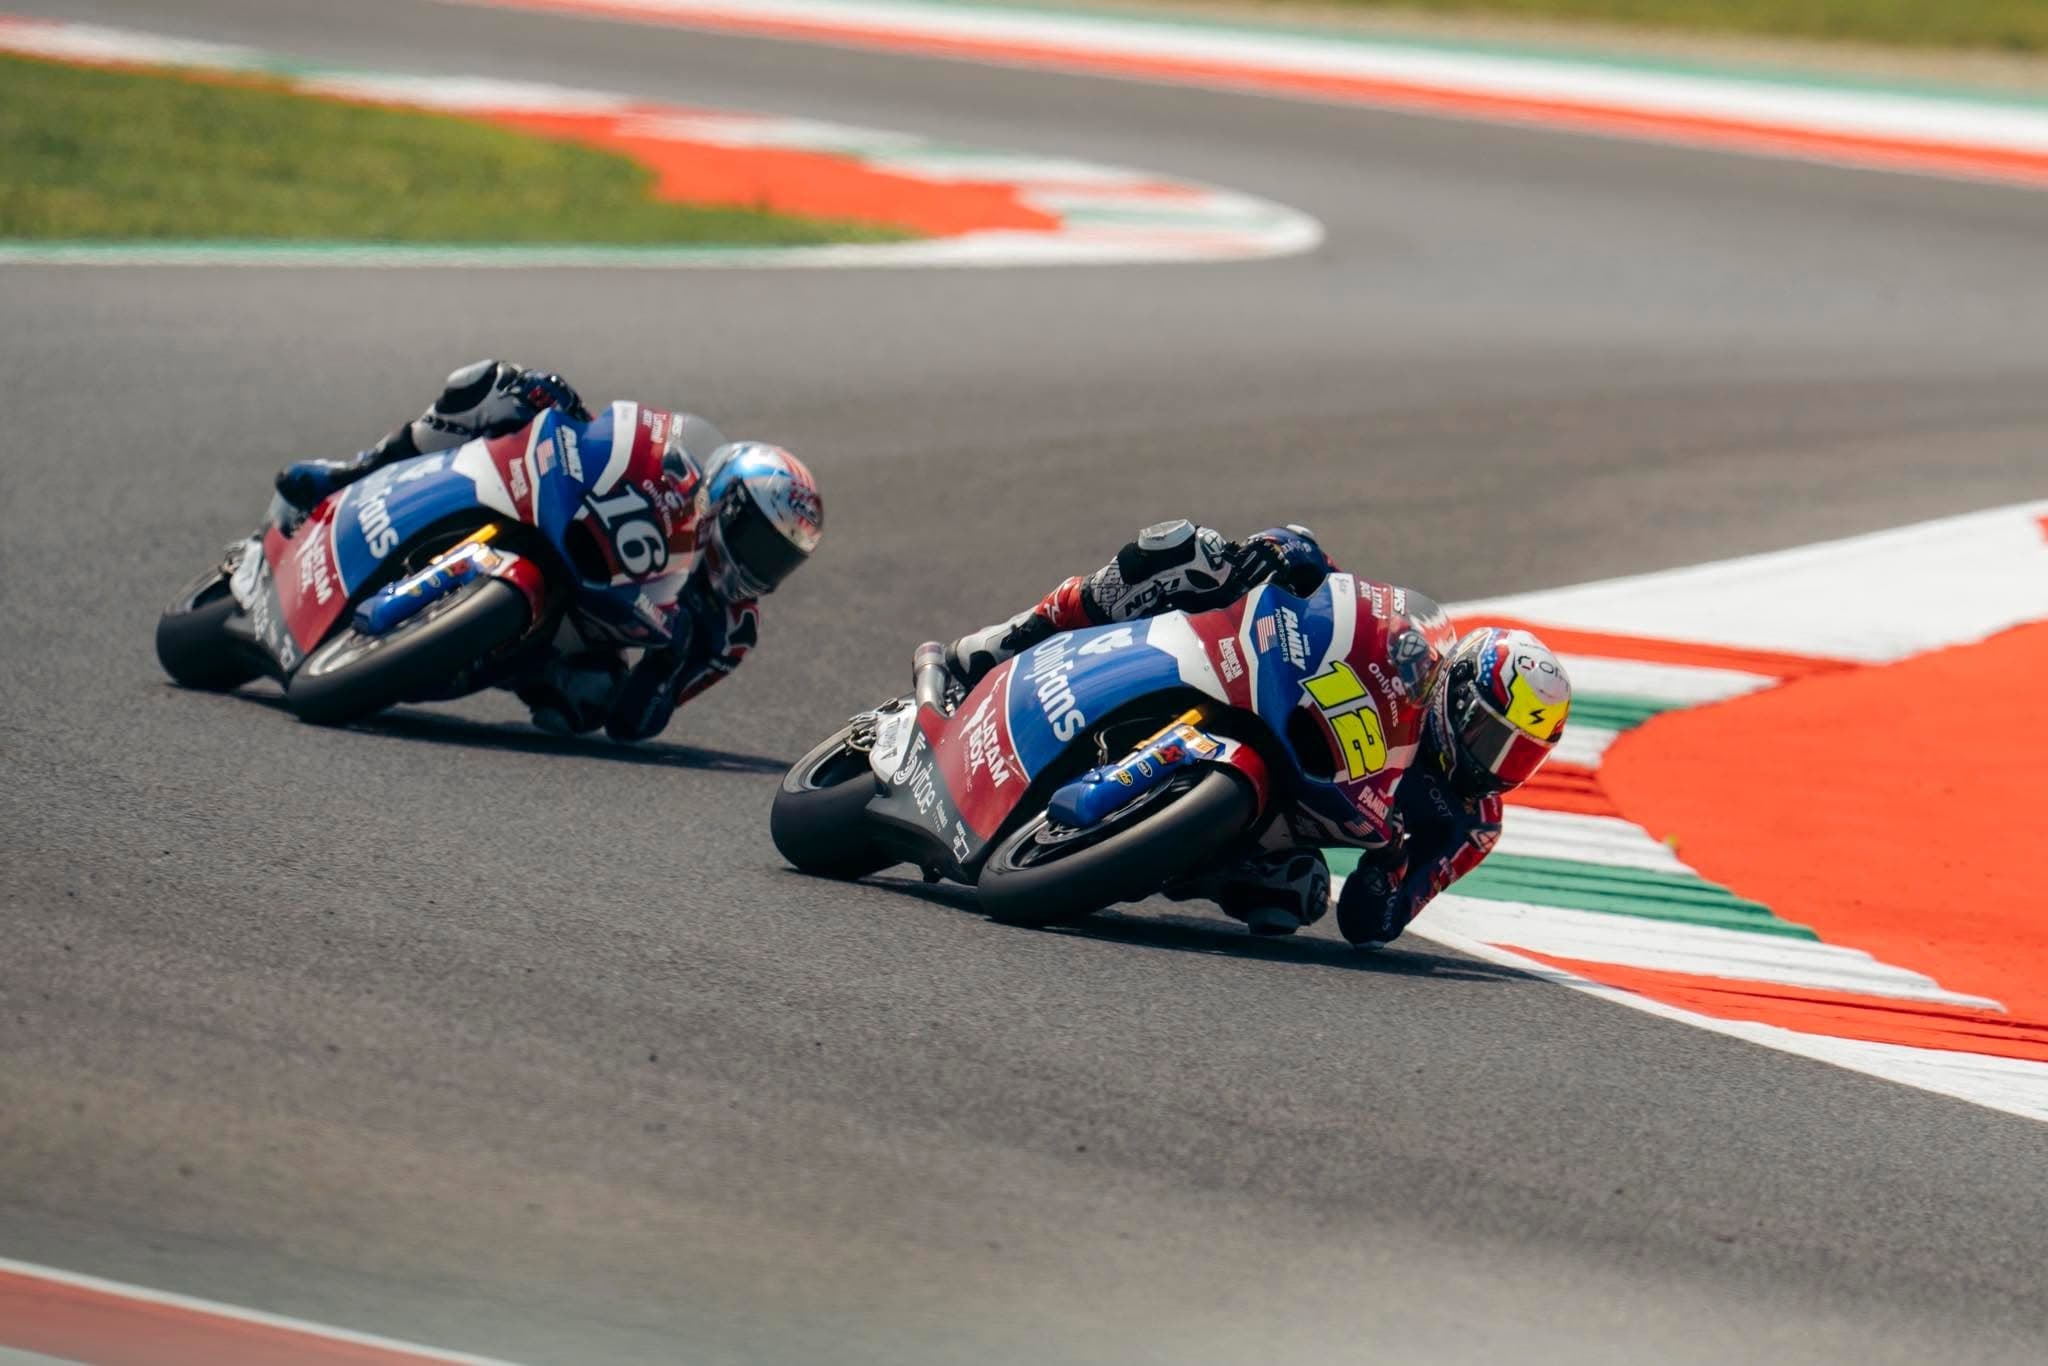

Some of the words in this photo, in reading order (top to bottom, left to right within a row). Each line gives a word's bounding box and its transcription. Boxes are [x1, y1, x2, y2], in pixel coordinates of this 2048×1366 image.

[586, 484, 669, 578] 16
[1218, 636, 1244, 680] AMERICAN
[1275, 608, 1290, 663] POWERSPORTS
[1281, 606, 1306, 671] FAMILY
[1023, 632, 1086, 742] OnlyFans
[1368, 662, 1399, 728] OnlyFans
[969, 724, 986, 776] BOX
[982, 708, 1010, 789] LATAM
[1299, 659, 1389, 785] 12
